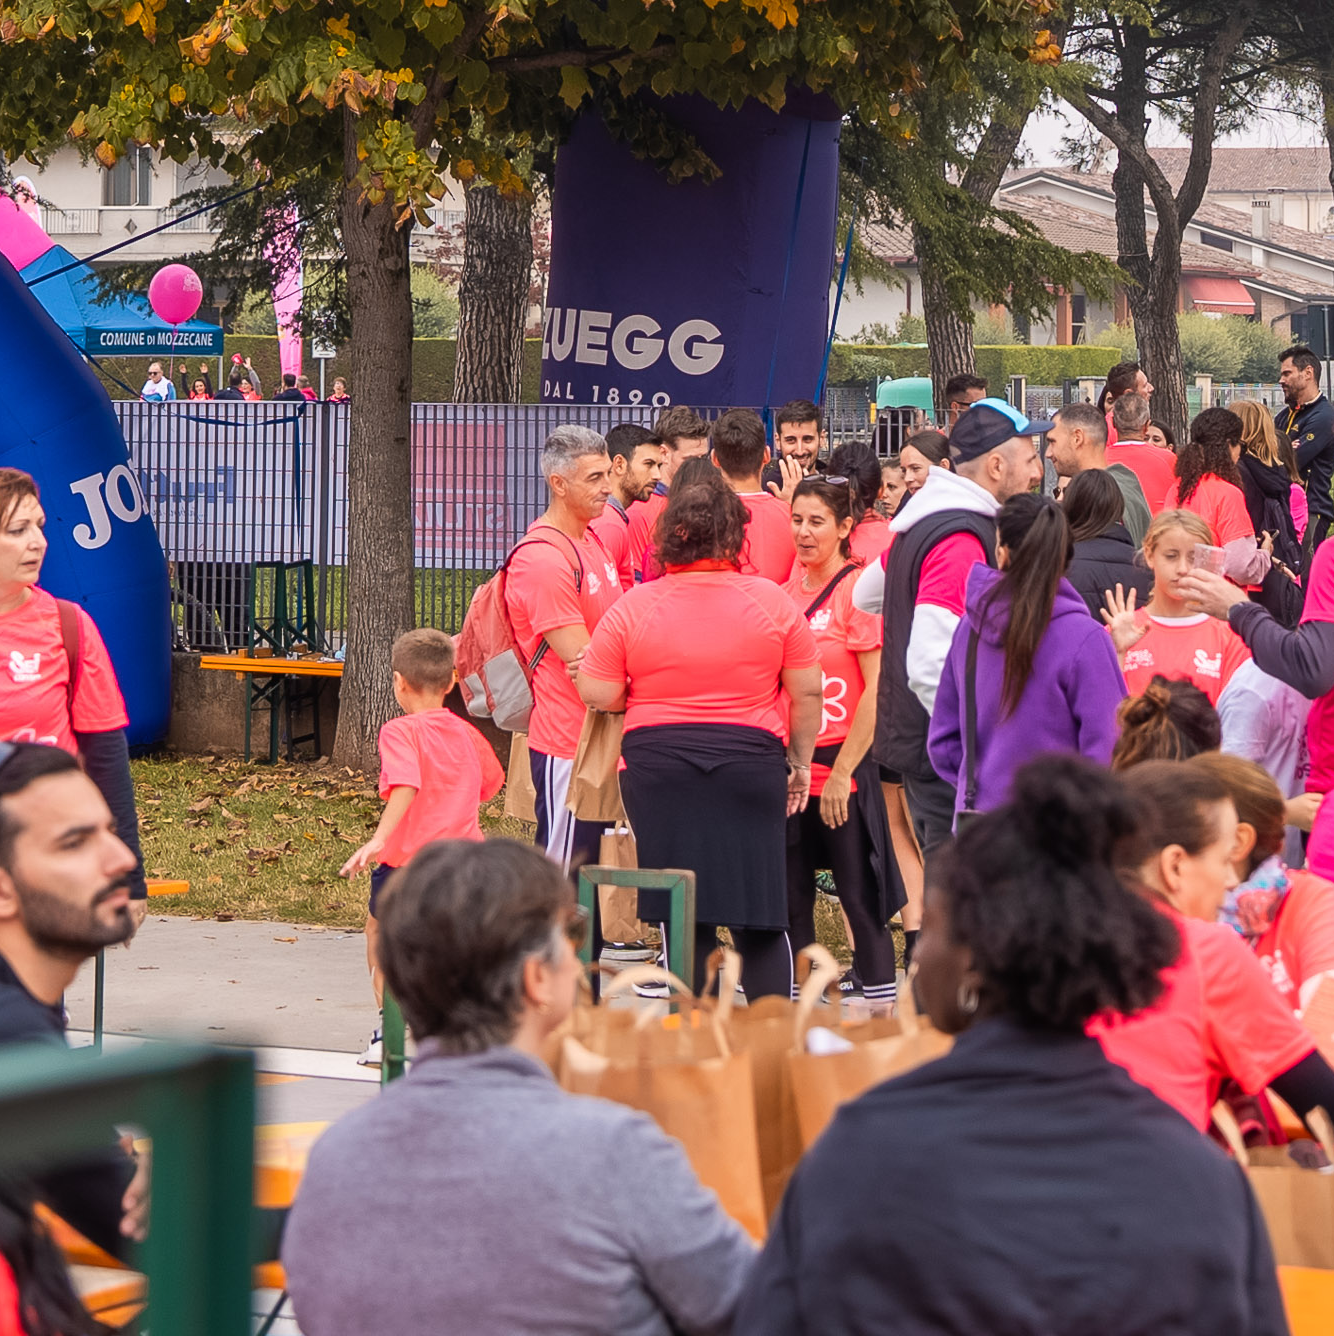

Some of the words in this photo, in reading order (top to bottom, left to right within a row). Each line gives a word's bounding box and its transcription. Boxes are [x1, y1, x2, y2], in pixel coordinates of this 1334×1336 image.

[100, 332, 145, 346] COMUNE
[157, 332, 213, 346] MOZZECANE
[543, 379, 575, 400] DAL
[592, 385, 671, 407] 1890
[69, 458, 149, 550] JO
